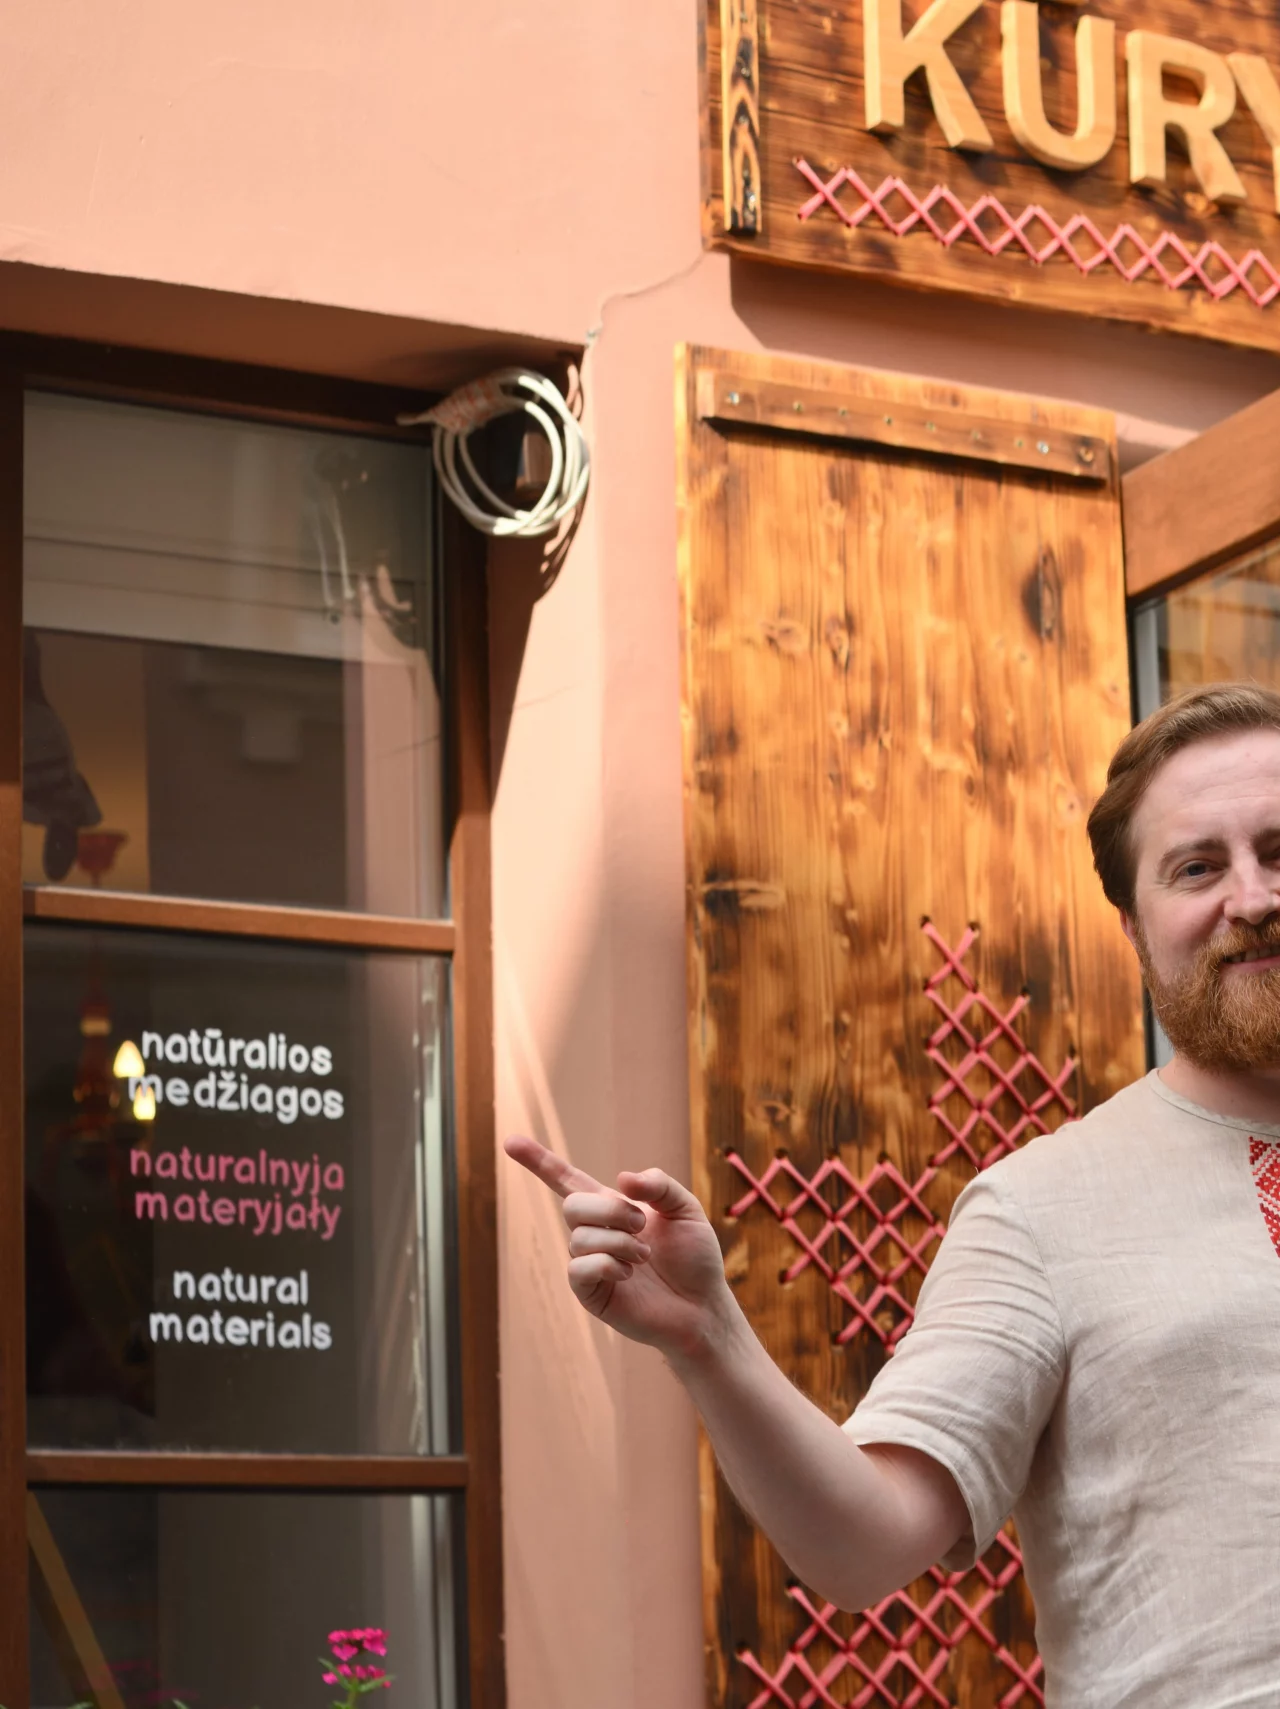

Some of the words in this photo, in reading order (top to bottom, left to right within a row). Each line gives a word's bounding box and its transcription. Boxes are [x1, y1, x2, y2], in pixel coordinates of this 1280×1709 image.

[141, 1028, 333, 1075] natūralios
[128, 1070, 344, 1124] medžiagos
[130, 1146, 344, 1196] naturalnyja
[134, 1191, 341, 1240] materyjały
[173, 1267, 308, 1305] natural
[149, 1310, 332, 1349] materials
